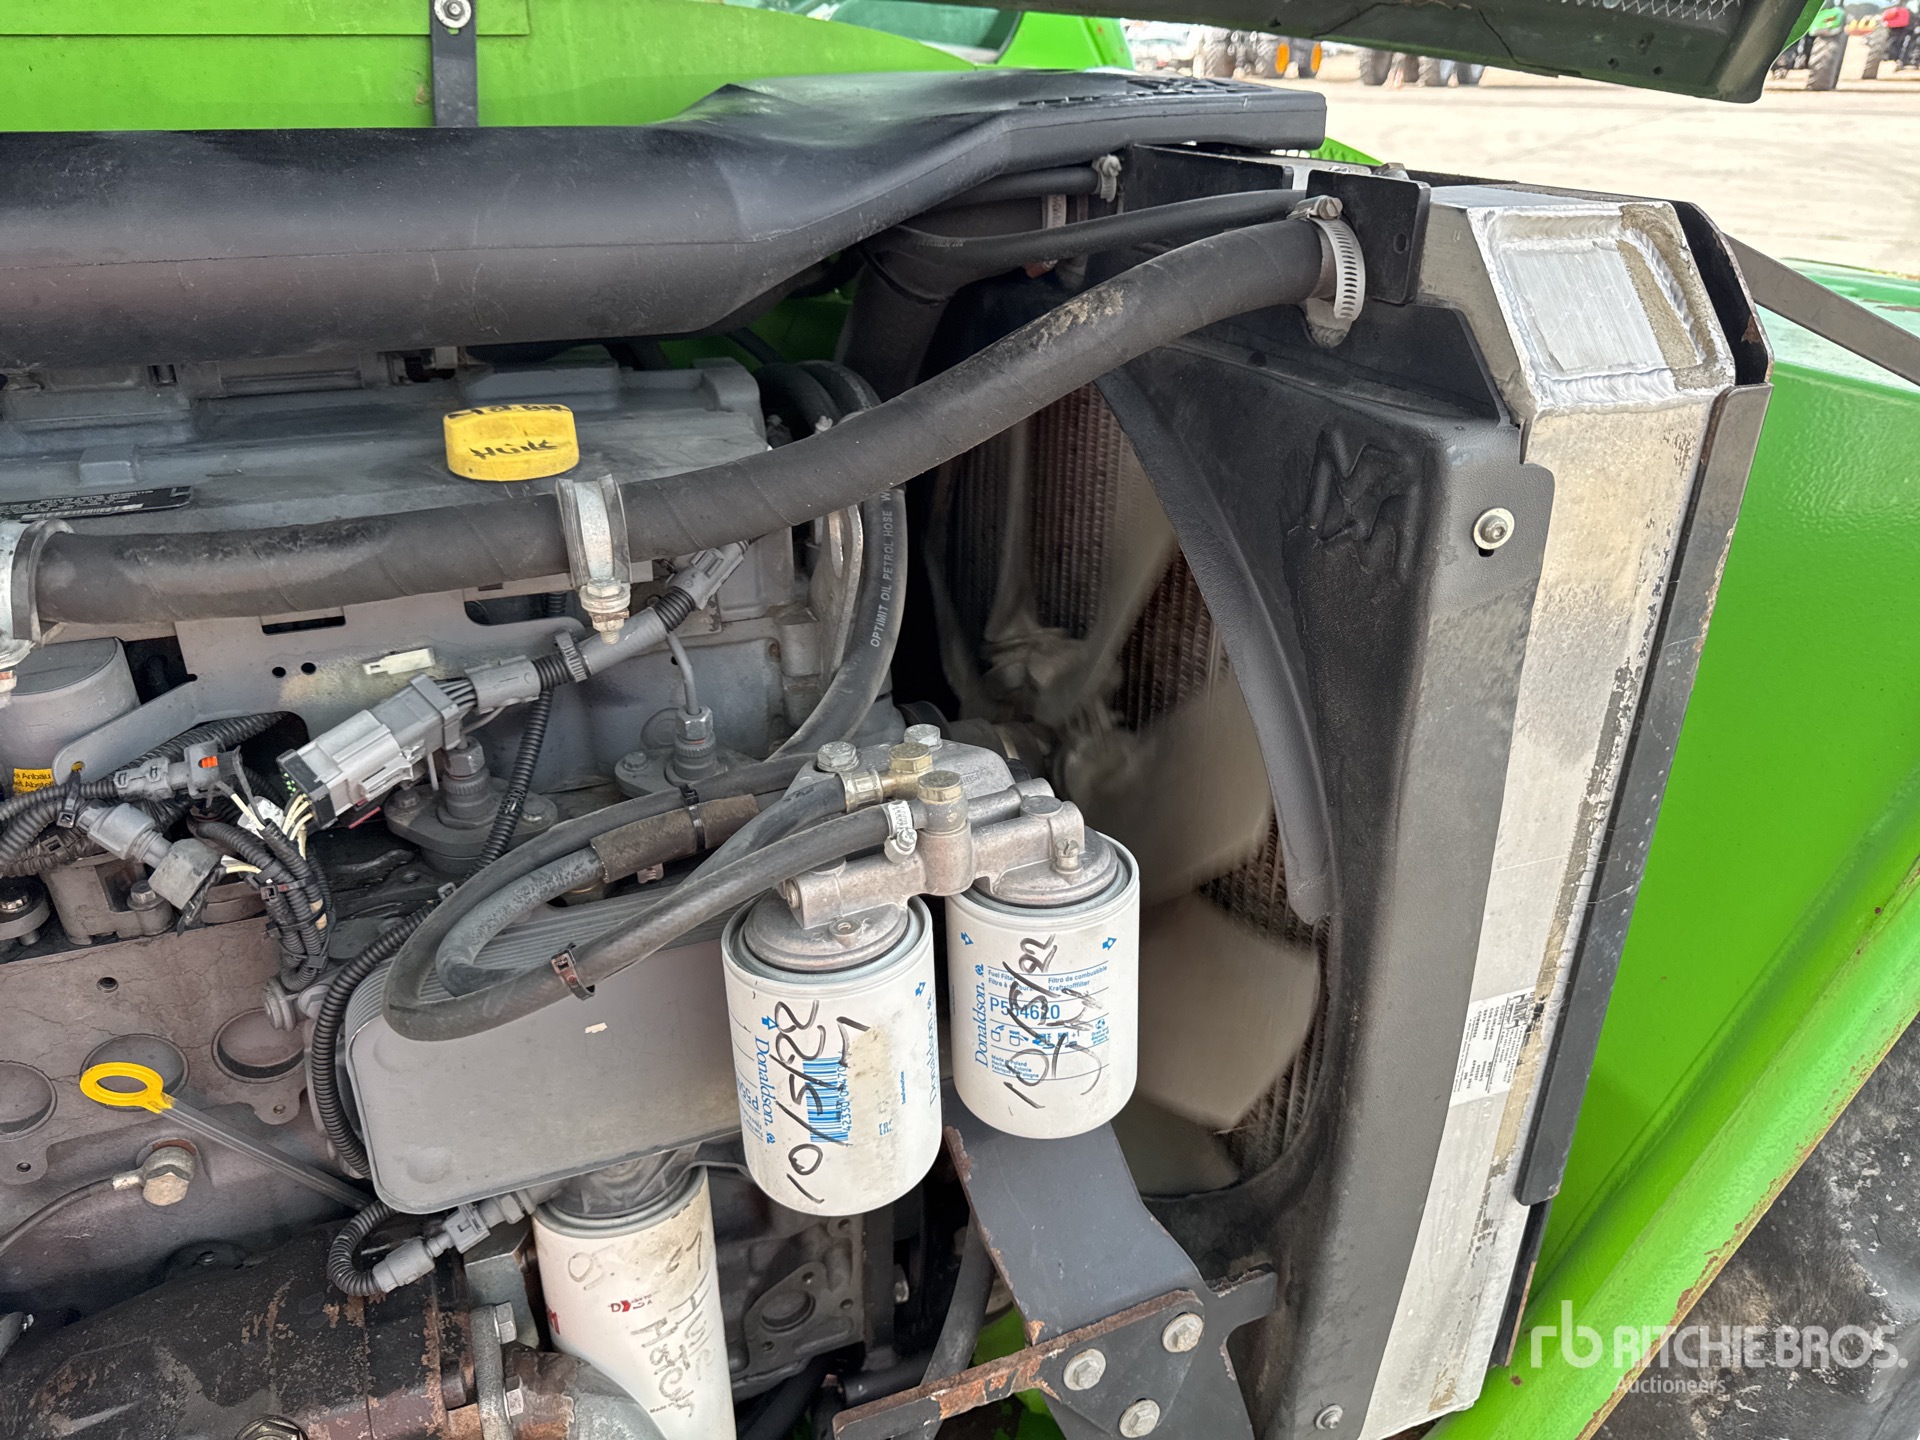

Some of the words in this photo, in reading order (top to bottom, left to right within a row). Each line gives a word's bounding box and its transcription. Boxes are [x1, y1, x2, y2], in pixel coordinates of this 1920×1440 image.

[882, 510, 894, 538] HOSE
[882, 542, 894, 581] PETROL
[881, 584, 893, 601] OIL
[870, 604, 889, 648] OPTIMIT
